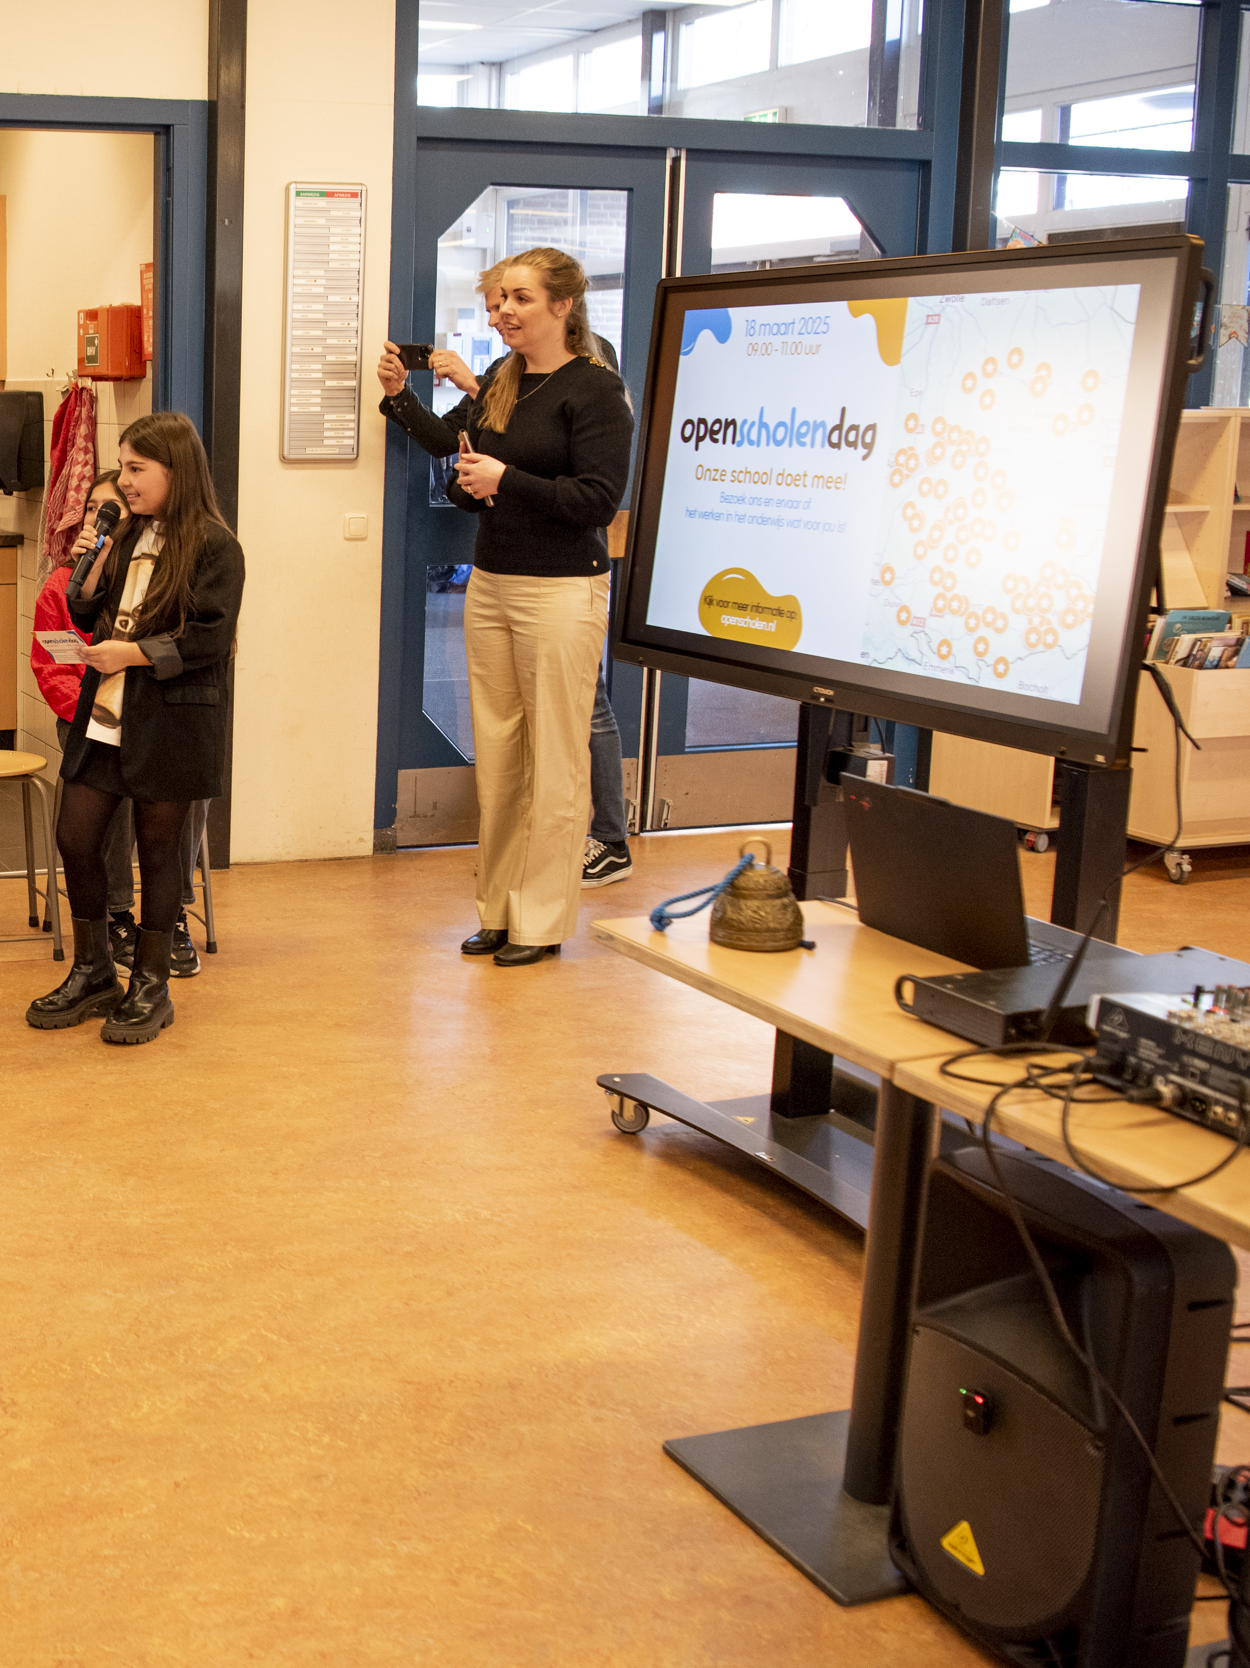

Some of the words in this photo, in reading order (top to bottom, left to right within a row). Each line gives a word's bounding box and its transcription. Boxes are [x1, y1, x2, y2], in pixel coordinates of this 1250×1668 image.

[939, 294, 966, 304] Zwolle
[744, 319, 756, 337] 18
[758, 319, 796, 337] maart
[798, 315, 831, 336] 2025
[747, 342, 773, 356] 09.00
[781, 341, 803, 355] 11.00
[805, 342, 822, 356] uur
[680, 406, 877, 461] openscholendag
[695, 463, 727, 482] Onze
[730, 466, 773, 487] school
[776, 468, 808, 488] doet
[811, 472, 848, 491] mee!
[719, 491, 747, 505] Bezoek
[748, 496, 763, 507] ons
[764, 497, 774, 507] en
[775, 498, 802, 510] ervaar
[802, 497, 812, 510] of
[685, 506, 698, 519] het
[698, 508, 725, 522] werken
[726, 510, 733, 522] in
[734, 511, 747, 524] het
[747, 513, 785, 530] onderwijs
[786, 518, 802, 530] wat
[802, 520, 821, 532] voor
[821, 520, 836, 534] jou
[703, 595, 715, 609] Kijk
[716, 599, 731, 608] voor
[731, 601, 750, 612] meer
[750, 602, 785, 617] informatie
[720, 614, 777, 632] openscholen.nl
[1018, 680, 1049, 694] Bocholt
